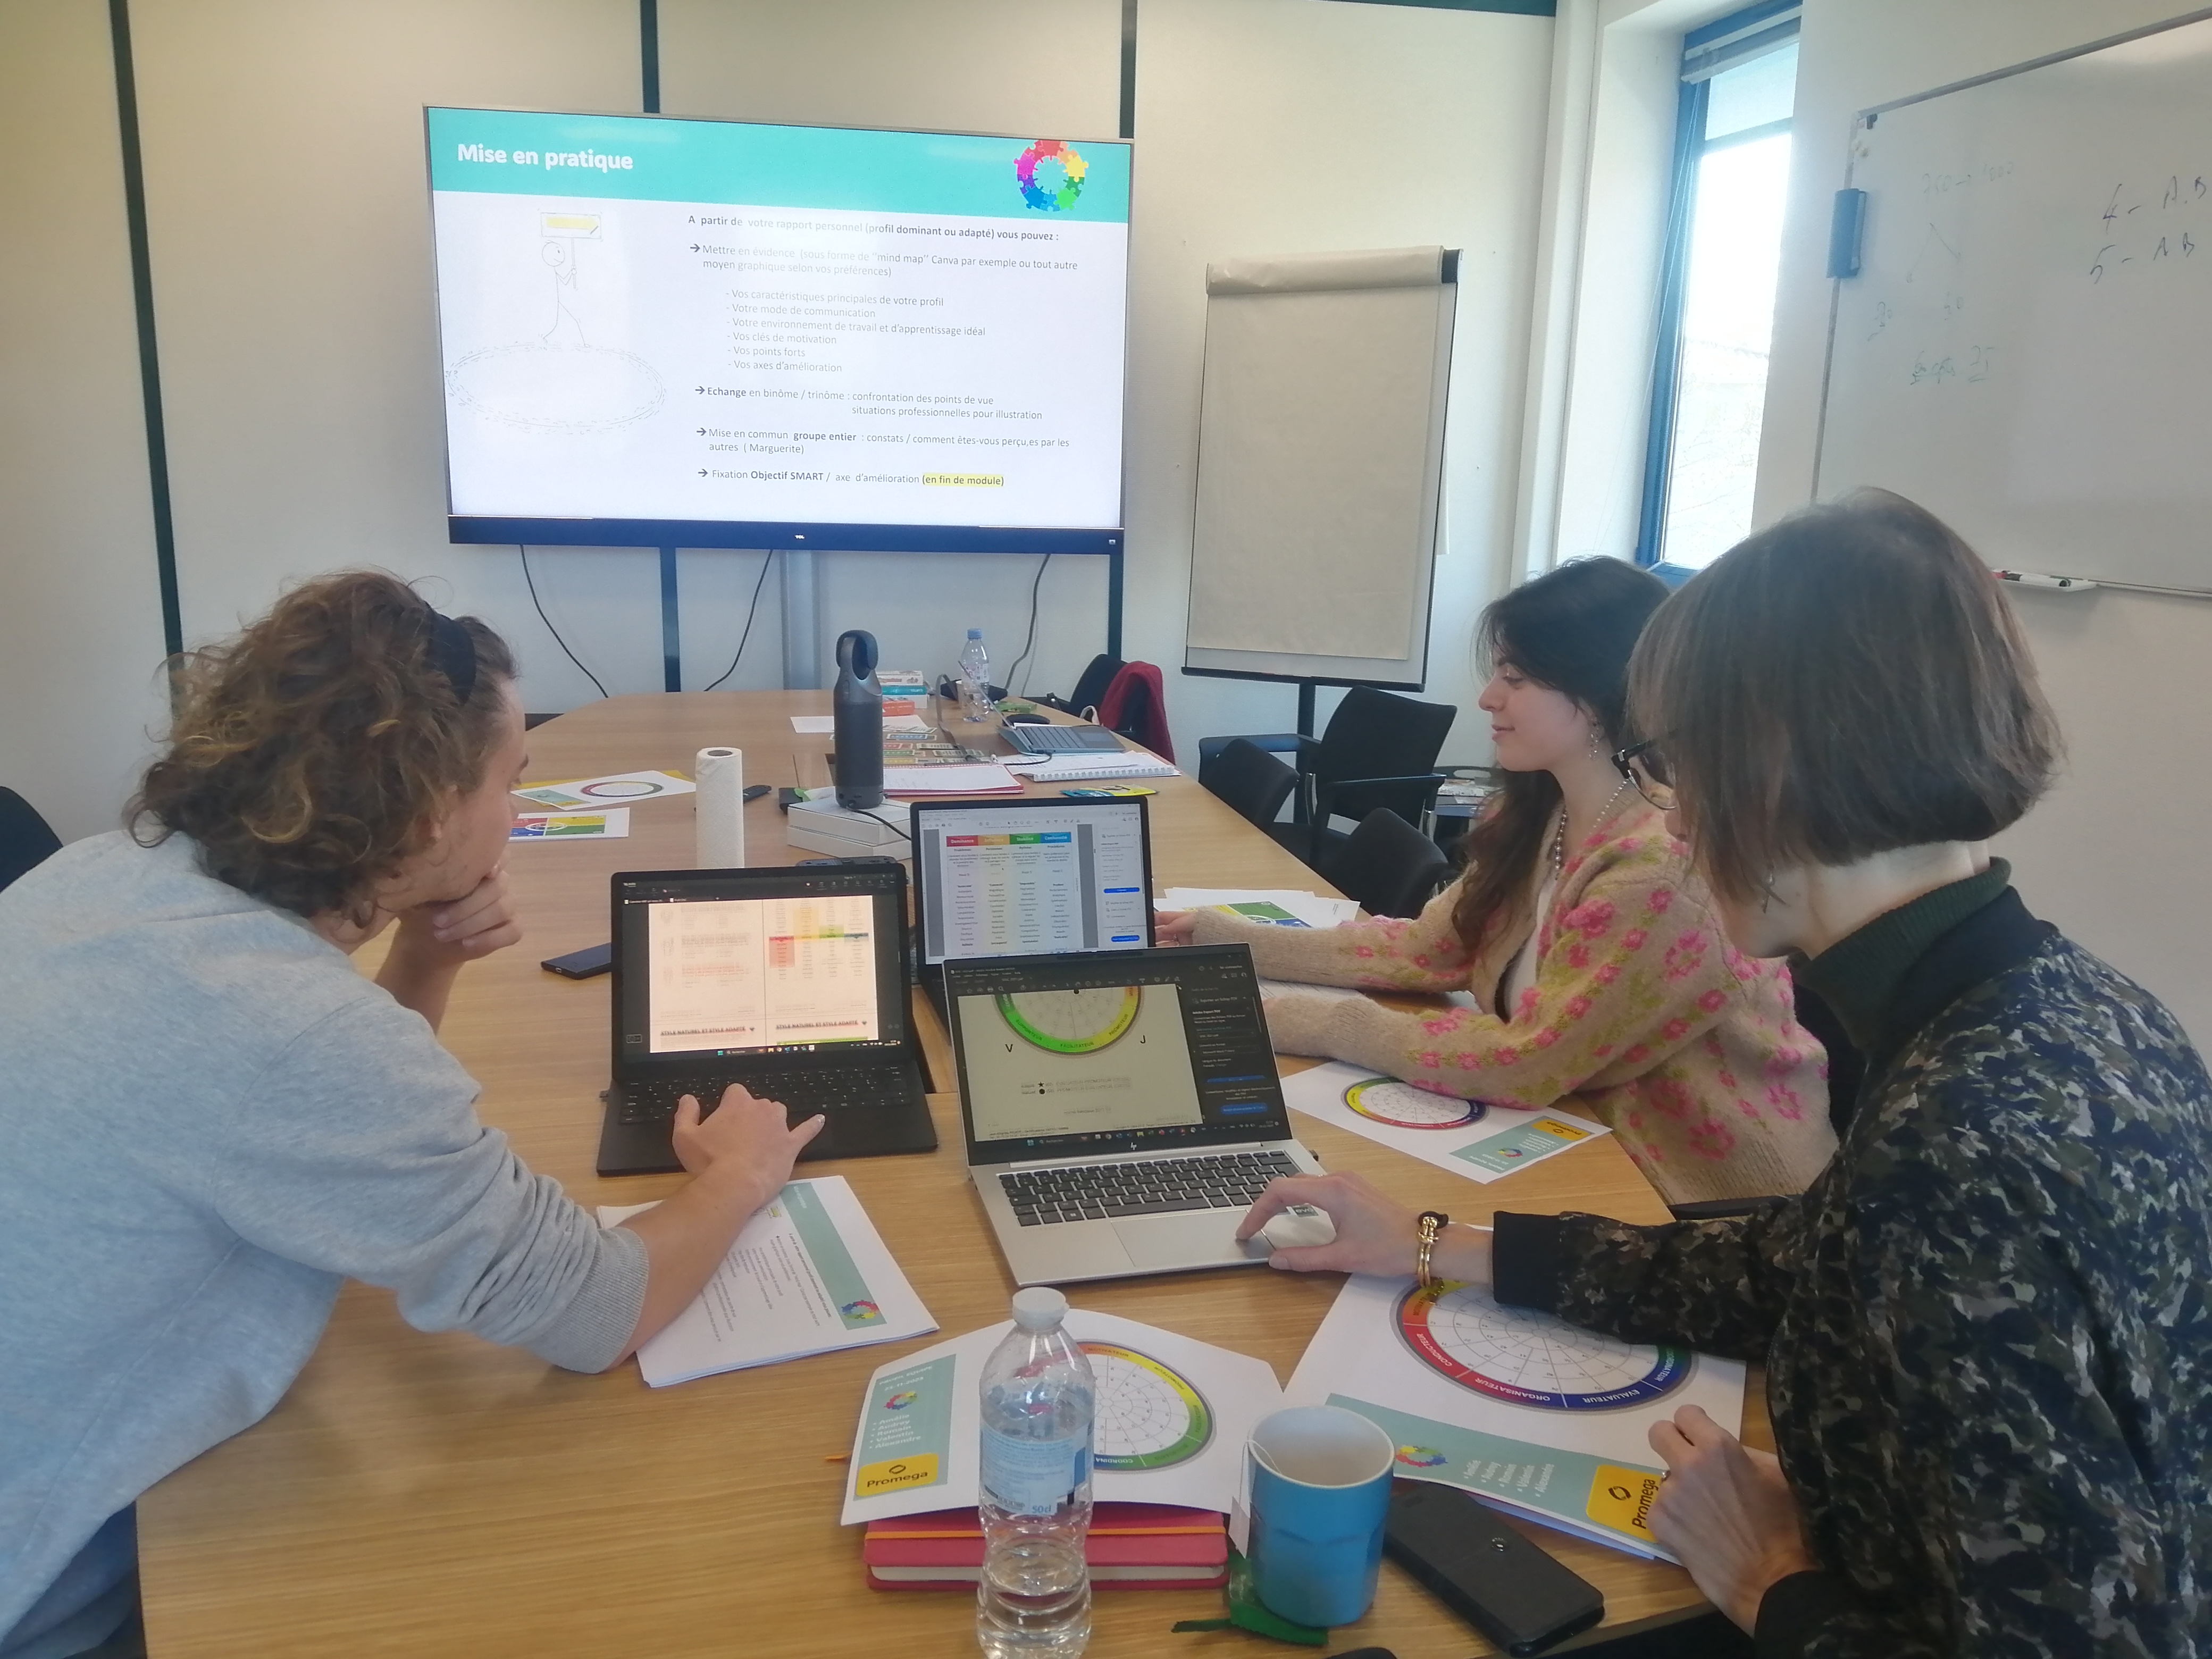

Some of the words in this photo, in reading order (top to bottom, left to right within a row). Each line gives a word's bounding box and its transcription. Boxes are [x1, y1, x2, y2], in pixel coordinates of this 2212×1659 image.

[458, 144, 507, 163] Mise
[513, 151, 538, 165] en
[546, 148, 634, 173] pratique
[688, 215, 696, 223] A
[701, 215, 728, 228] partir
[730, 216, 743, 226] de
[748, 218, 774, 228] votre
[776, 219, 812, 231] rapport
[815, 220, 862, 234] personnel
[865, 222, 894, 233] (profil
[896, 224, 942, 236] dominant
[958, 227, 994, 240] adapté)
[996, 231, 1018, 239] vous
[1021, 232, 1053, 242] pouvez
[702, 244, 736, 255] Mettre
[738, 247, 750, 256] en
[753, 246, 795, 258] évidence
[800, 248, 825, 261] (sous
[827, 249, 856, 261] forme
[858, 251, 869, 261] de
[932, 254, 959, 265] Canva
[961, 257, 977, 267] par
[978, 256, 1017, 269] exemple
[1019, 259, 1031, 268] ou
[1033, 259, 1052, 269] tout
[1054, 261, 1078, 270] autre
[703, 260, 735, 271] moyen
[738, 261, 786, 273] graphique
[788, 262, 813, 273] selon
[815, 265, 832, 274] vos
[834, 264, 892, 278] préférences)
[731, 288, 749, 298] Vos
[751, 289, 825, 303] caractéristiques
[827, 292, 877, 305] principales
[879, 295, 891, 304] de
[893, 296, 917, 305] votre
[920, 296, 944, 308] profil
[732, 303, 758, 313] Votre
[760, 304, 787, 314] mode
[790, 305, 802, 315] de
[804, 306, 876, 317] communication
[732, 317, 759, 327] Votre
[761, 318, 832, 330] environnement
[834, 321, 846, 331] de
[848, 322, 877, 332] travail
[879, 324, 889, 333] et
[964, 326, 985, 336] idéal
[732, 331, 750, 341] Vos
[752, 332, 770, 342] clés
[772, 332, 784, 342] de
[786, 333, 837, 345] motivation
[733, 345, 751, 355] Vos
[753, 347, 782, 358] points
[784, 347, 806, 357] forts
[733, 359, 751, 369] Vos
[707, 386, 747, 398] Echange
[763, 388, 798, 398] binôme
[807, 389, 844, 400] trinôme
[852, 390, 914, 403] confrontation
[916, 393, 932, 403] des
[934, 394, 962, 406] points
[963, 395, 975, 404] de
[852, 406, 896, 415] situations
[899, 406, 971, 419] professionnelles
[973, 410, 994, 420] pour
[996, 409, 1043, 420] illustration
[709, 428, 731, 438] Mise
[748, 431, 788, 439] commun
[793, 432, 826, 442] groupe
[828, 432, 857, 441] entier
[866, 434, 904, 442] constats
[912, 435, 955, 444] comment
[957, 435, 1000, 445] êtes-vous
[1041, 439, 1055, 449] par
[1058, 438, 1069, 447] les
[709, 442, 739, 451] autres
[749, 442, 804, 455] Marguerite)
[712, 469, 748, 479] Fixation
[751, 470, 788, 482] Objectif
[790, 471, 824, 481] SMART
[922, 474, 937, 485] (en
[939, 474, 951, 483] fin
[953, 475, 965, 484] de
[967, 475, 1004, 487] module)
[1140, 1035, 1146, 1044] J
[1005, 1044, 1013, 1053] V
[1088, 1347, 1129, 1358] MOTIVATEUR
[1416, 1333, 1453, 1367] CONDUCTEUR
[1154, 1365, 1185, 1390] PROMOTEUR
[1474, 1377, 1551, 1402] ORGANISATEUR
[1582, 1389, 1640, 1404] ÉVALUATEUR
[878, 1419, 910, 1430] Audrey
[879, 1413, 910, 1425] Amélie
[876, 1430, 914, 1442] Valentin
[877, 1425, 912, 1437] Romain
[875, 1435, 921, 1449] Alexandre
[867, 1471, 928, 1488] Promega
[1631, 1478, 1656, 1529] Promega
